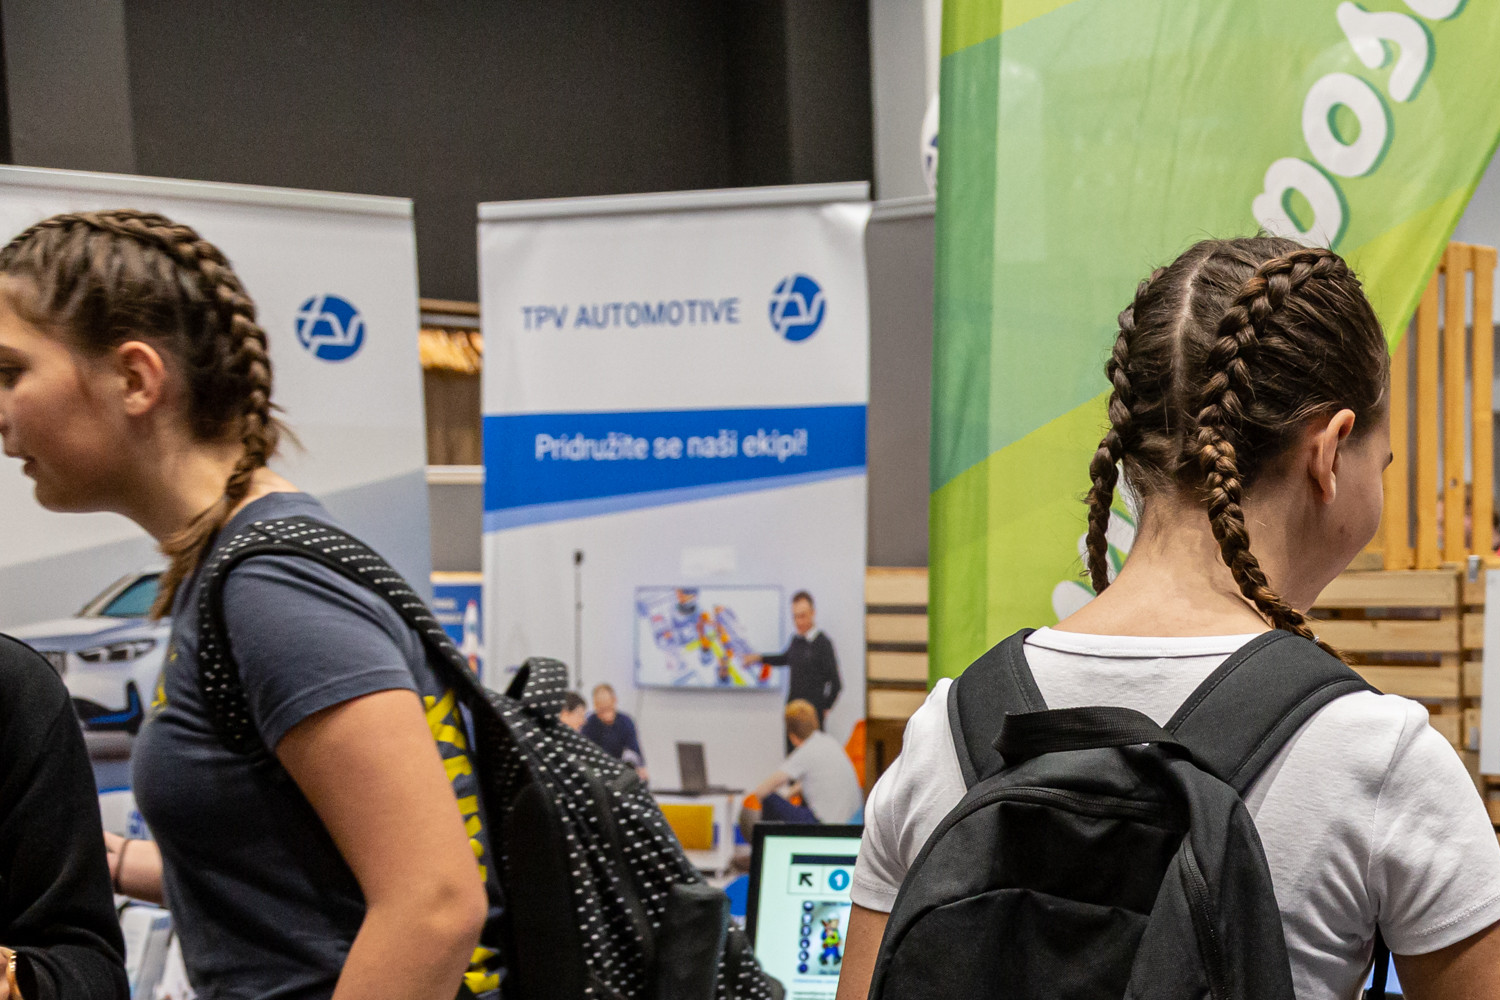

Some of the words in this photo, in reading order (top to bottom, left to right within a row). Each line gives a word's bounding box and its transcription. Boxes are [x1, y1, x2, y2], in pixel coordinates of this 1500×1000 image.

[521, 305, 568, 331] TPV
[574, 298, 740, 329] AUTOMOTIVE
[534, 431, 649, 461] Pridružite
[653, 436, 683, 460] se
[687, 429, 738, 459] naši
[742, 428, 808, 463] ekipi!
